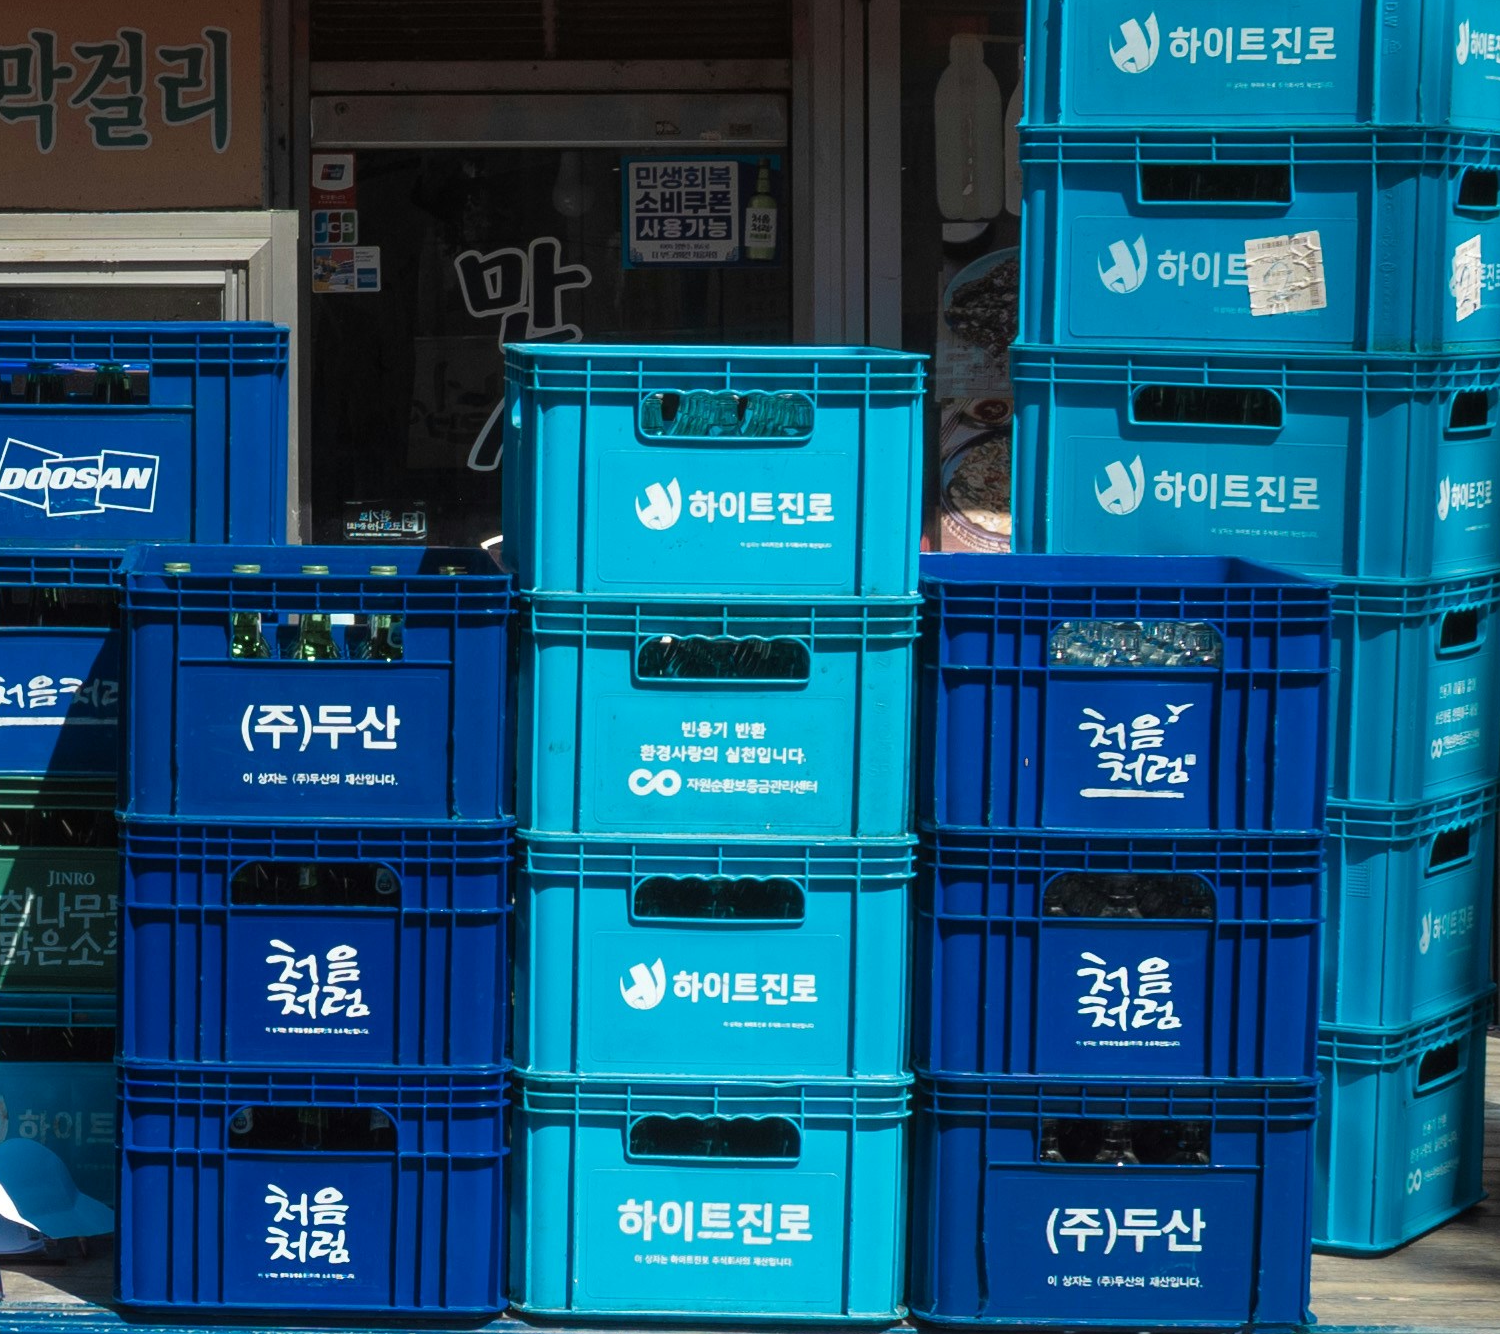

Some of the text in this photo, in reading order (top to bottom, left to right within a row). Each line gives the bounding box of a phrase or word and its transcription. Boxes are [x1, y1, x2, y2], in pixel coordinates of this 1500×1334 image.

[1168, 25, 1337, 65] 하이트진로
[635, 166, 732, 190] 민생회복
[635, 190, 732, 214] 소비쿠폰
[315, 221, 354, 234] JCB
[638, 217, 729, 239] 사용가능
[0, 464, 153, 491] DOOSAN
[1152, 470, 1321, 513] 하이트진로
[1450, 478, 1493, 510] 하이트진로
[688, 490, 835, 525] 하이트진로
[240, 703, 400, 753] (주)두산
[681, 721, 767, 739] 빈용기 반환
[1078, 707, 1165, 751] 처음
[639, 744, 807, 764] 환경사랑의 실천입니다.
[1097, 751, 1190, 785] 처럼
[243, 772, 253, 786] 이
[256, 772, 288, 786] 상자는
[344, 772, 399, 786] 재산입니다.
[47, 870, 95, 887] JINRO
[265, 938, 359, 983] 처음
[1077, 952, 1172, 996] 처음
[267, 983, 370, 1019] 처럼
[672, 971, 819, 1006] 하이트진로
[1078, 996, 1183, 1031] 처럼
[265, 1184, 349, 1227] 처음
[617, 1198, 814, 1245] 하이트진로
[265, 1226, 350, 1264] 처럼
[1046, 1208, 1206, 1254] (주)두산
[1047, 1275, 1057, 1288] 이
[1062, 1275, 1092, 1288] 상자는
[1149, 1275, 1204, 1288] 재산입니다.
